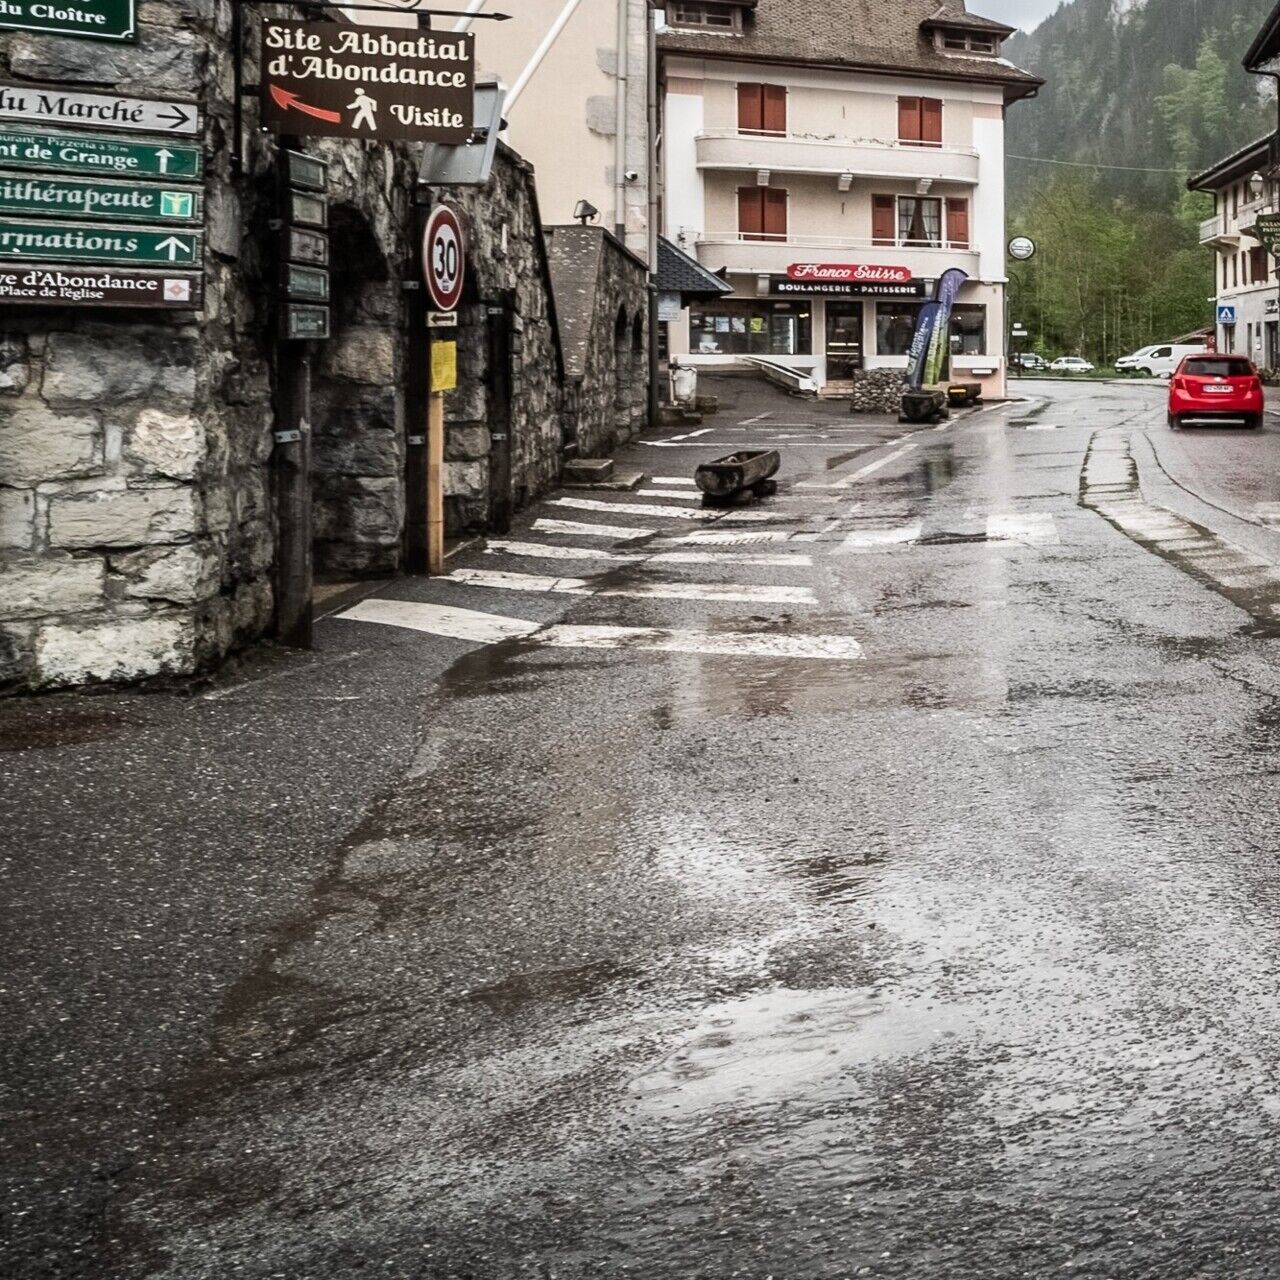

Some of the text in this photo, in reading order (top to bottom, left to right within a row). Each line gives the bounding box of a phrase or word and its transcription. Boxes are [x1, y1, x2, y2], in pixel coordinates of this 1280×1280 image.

[30, 4, 106, 24] Cloître
[266, 26, 469, 61] Site Abbatial
[268, 55, 467, 88] d'Abondance
[37, 94, 145, 123] Marché
[390, 105, 464, 128] Visite
[47, 137, 96, 149] Pizzeria
[25, 144, 53, 161] de
[60, 148, 139, 170] Grange
[0, 181, 155, 213] ithérapeute
[435, 236, 457, 281] 30
[23, 271, 158, 291] d'Abondance
[794, 264, 905, 280] Franco Suisse
[0, 286, 105, 300] Place de l'église
[778, 284, 917, 294] BOULANGERIE PATISSERIE
